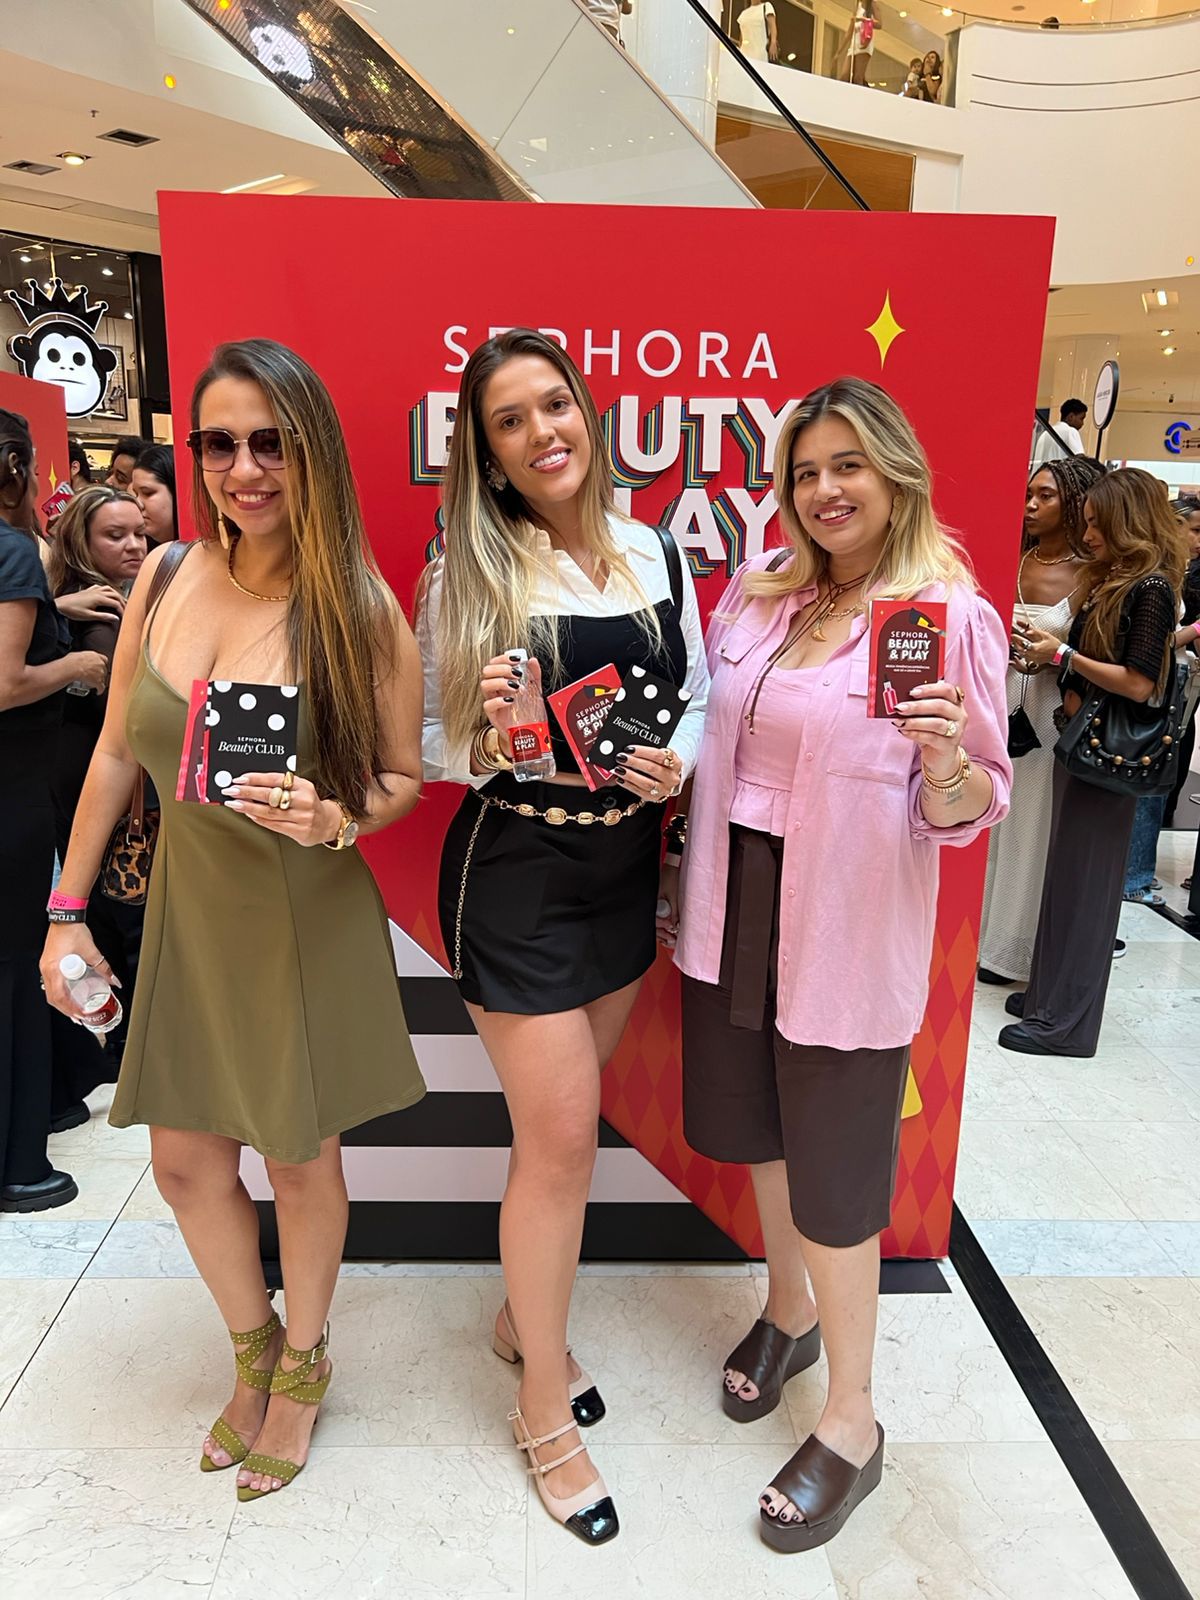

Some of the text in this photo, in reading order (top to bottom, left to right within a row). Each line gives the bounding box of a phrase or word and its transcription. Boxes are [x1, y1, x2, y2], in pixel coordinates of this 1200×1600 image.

[443, 325, 779, 379] SHORA
[412, 391, 800, 486] BUTY
[890, 631, 928, 639] SEPHORA
[887, 639, 931, 650] BEAUTY
[889, 650, 930, 661] & PLAY
[575, 698, 610, 719] SEPHORA
[583, 726, 593, 737] &
[612, 716, 661, 745] Beauty CLUB
[217, 740, 285, 755] Beauty CLUB
